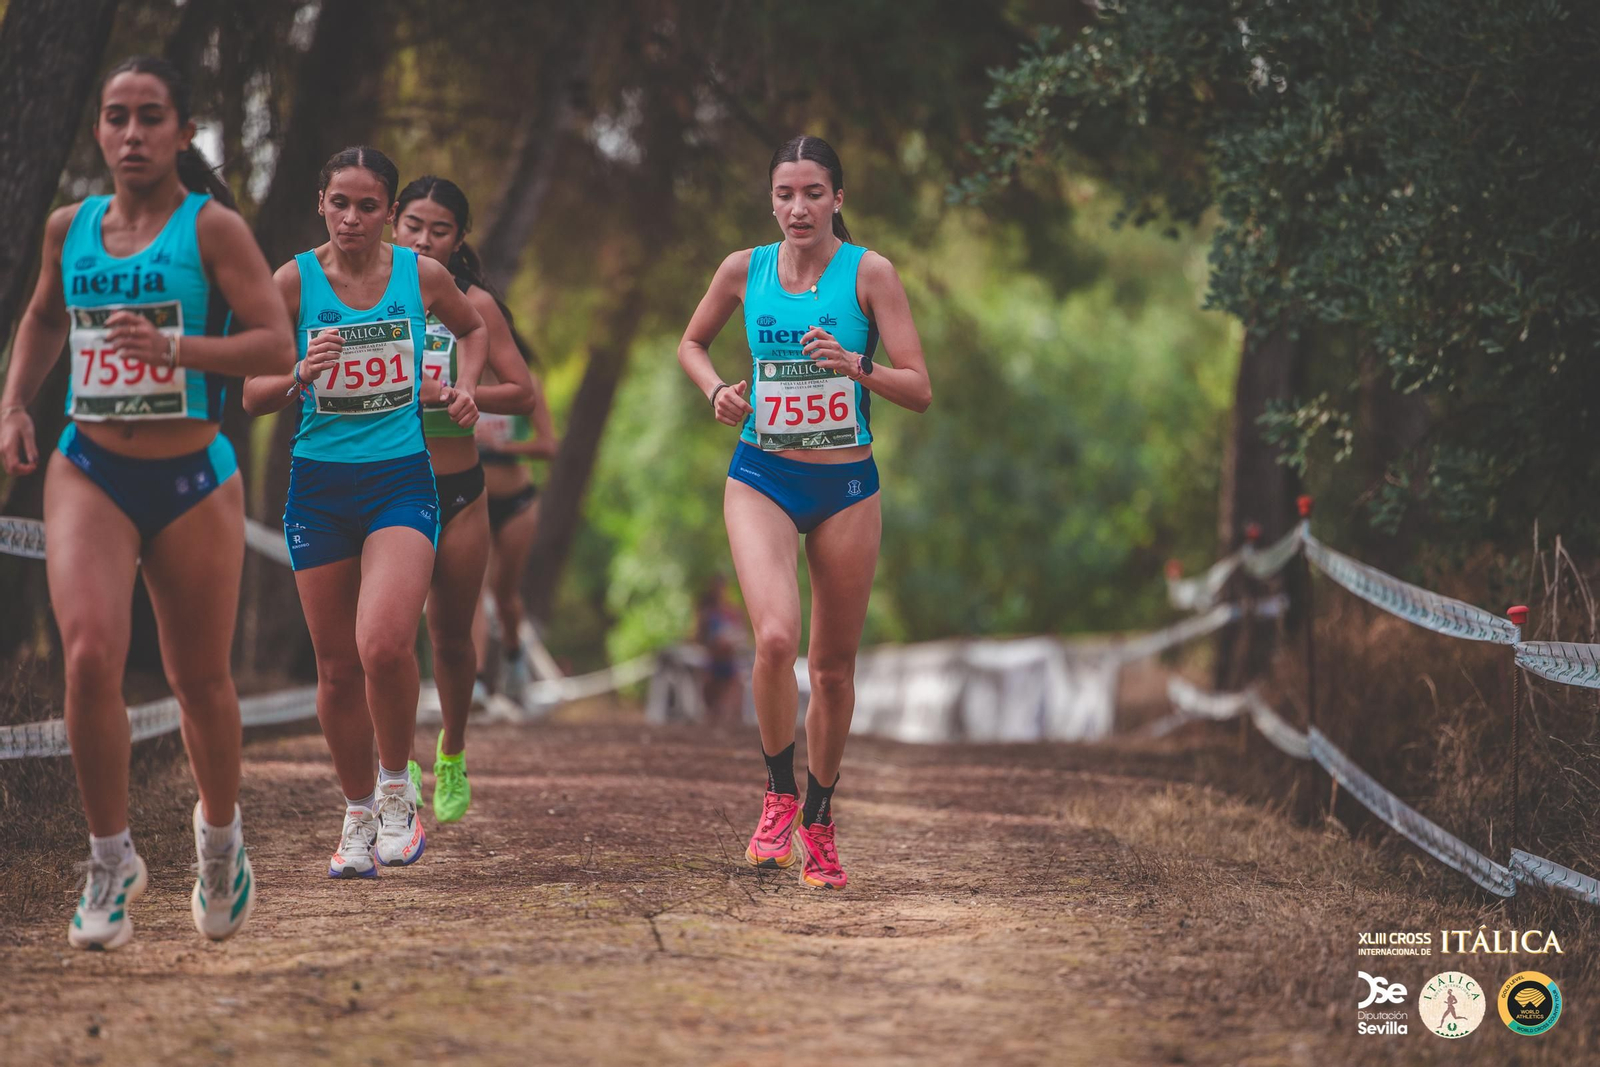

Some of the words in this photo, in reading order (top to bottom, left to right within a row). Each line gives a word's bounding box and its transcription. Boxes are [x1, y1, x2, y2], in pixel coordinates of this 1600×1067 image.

[72, 266, 166, 299] nerja
[326, 354, 409, 390] 7591
[765, 392, 849, 426] 7556
